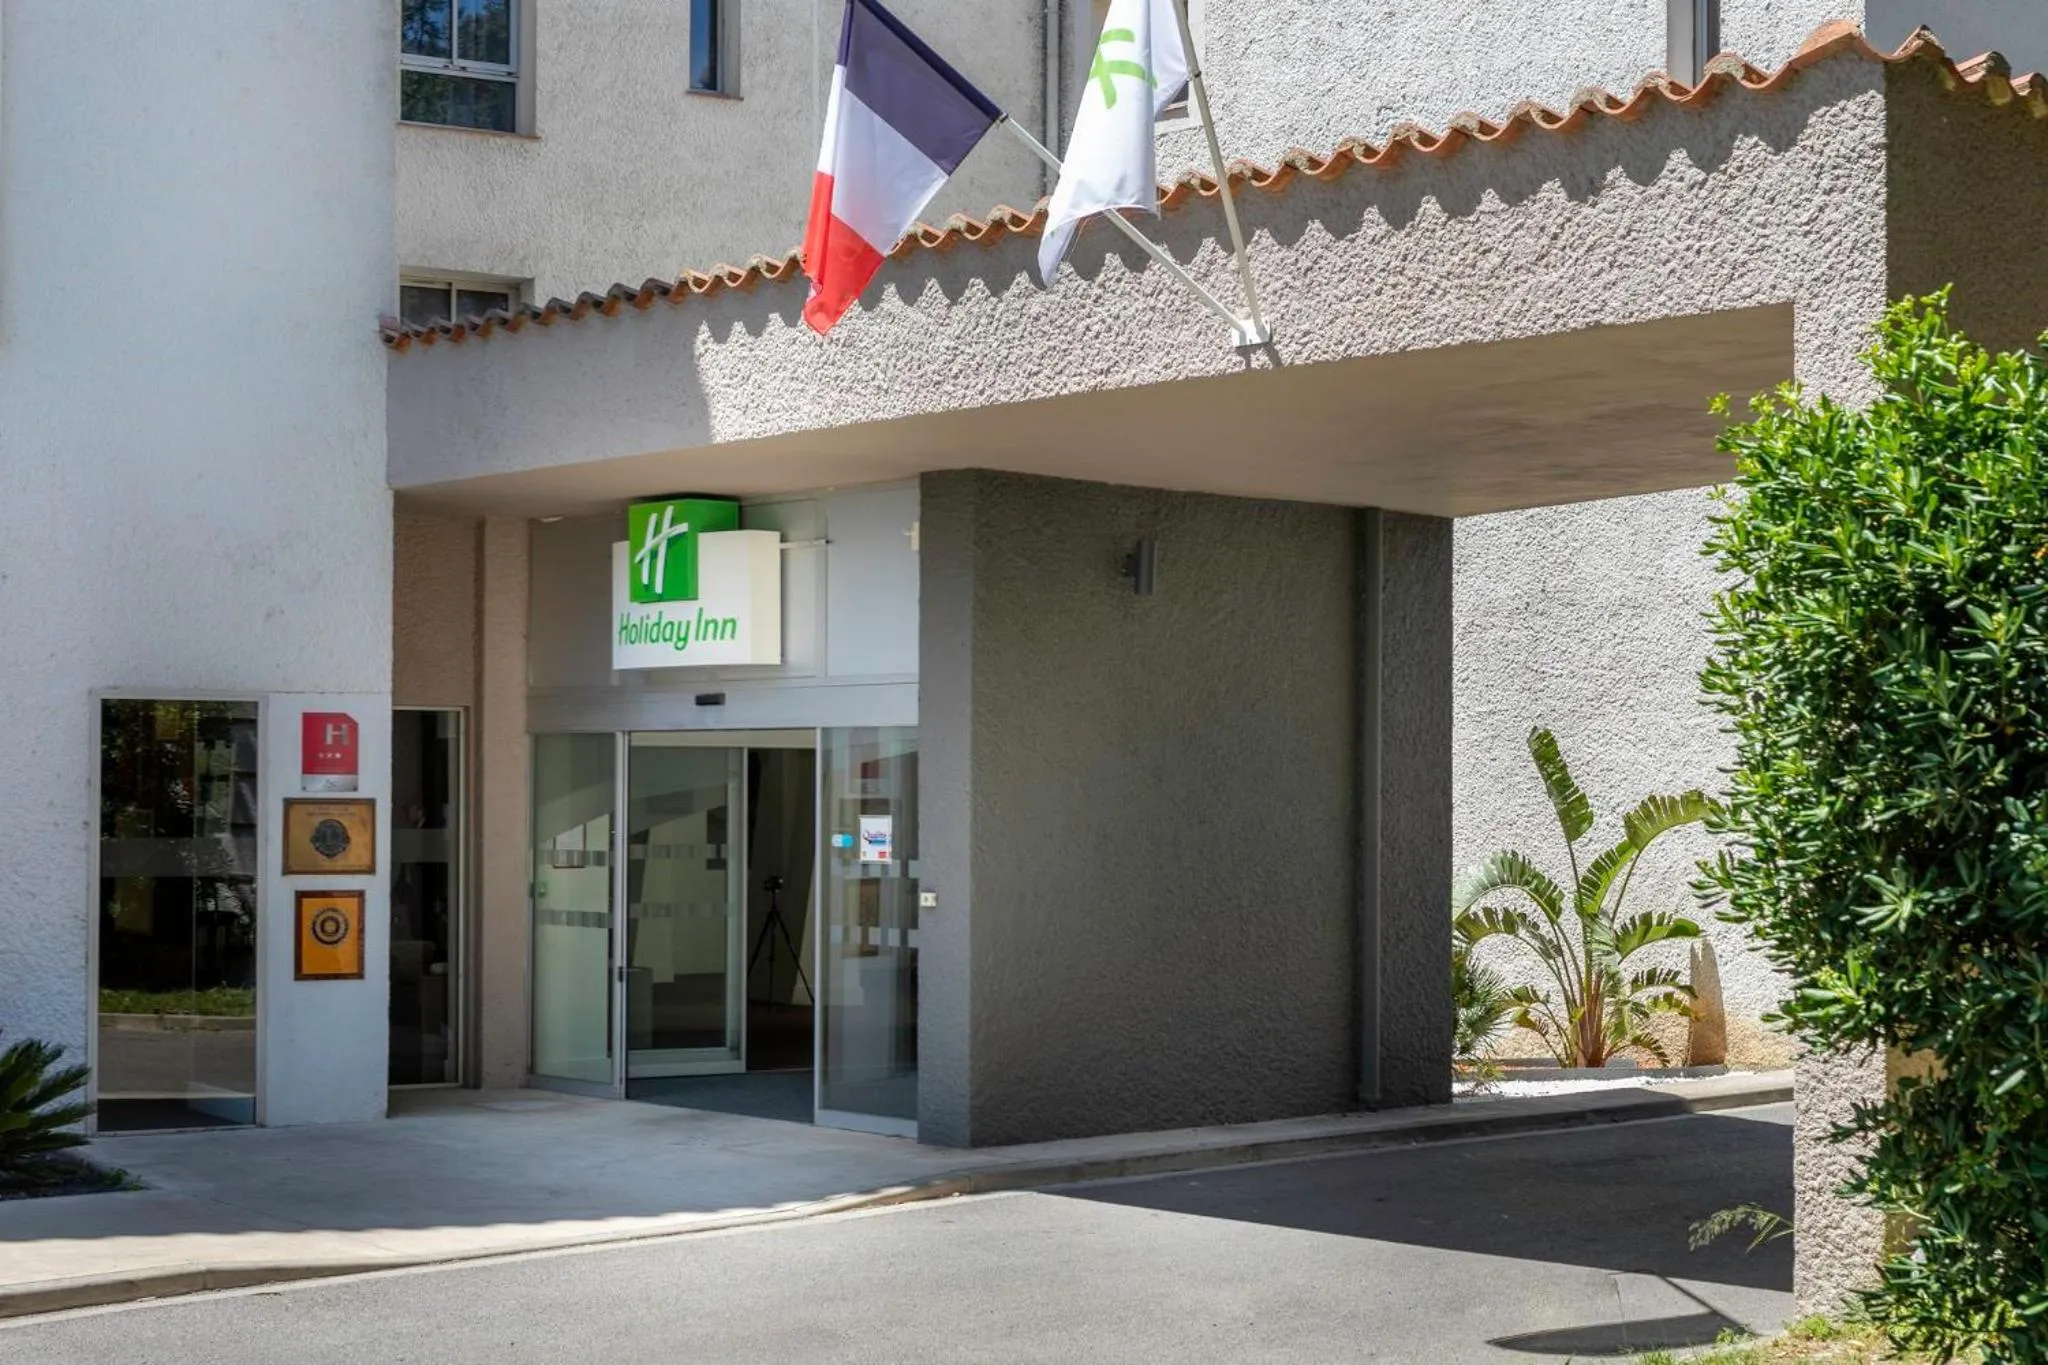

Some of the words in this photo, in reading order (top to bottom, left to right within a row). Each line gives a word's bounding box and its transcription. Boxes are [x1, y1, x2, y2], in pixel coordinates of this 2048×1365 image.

[634, 505, 689, 594] H
[618, 610, 691, 651] Holiday
[695, 607, 737, 641] Inn
[325, 723, 350, 746] H
